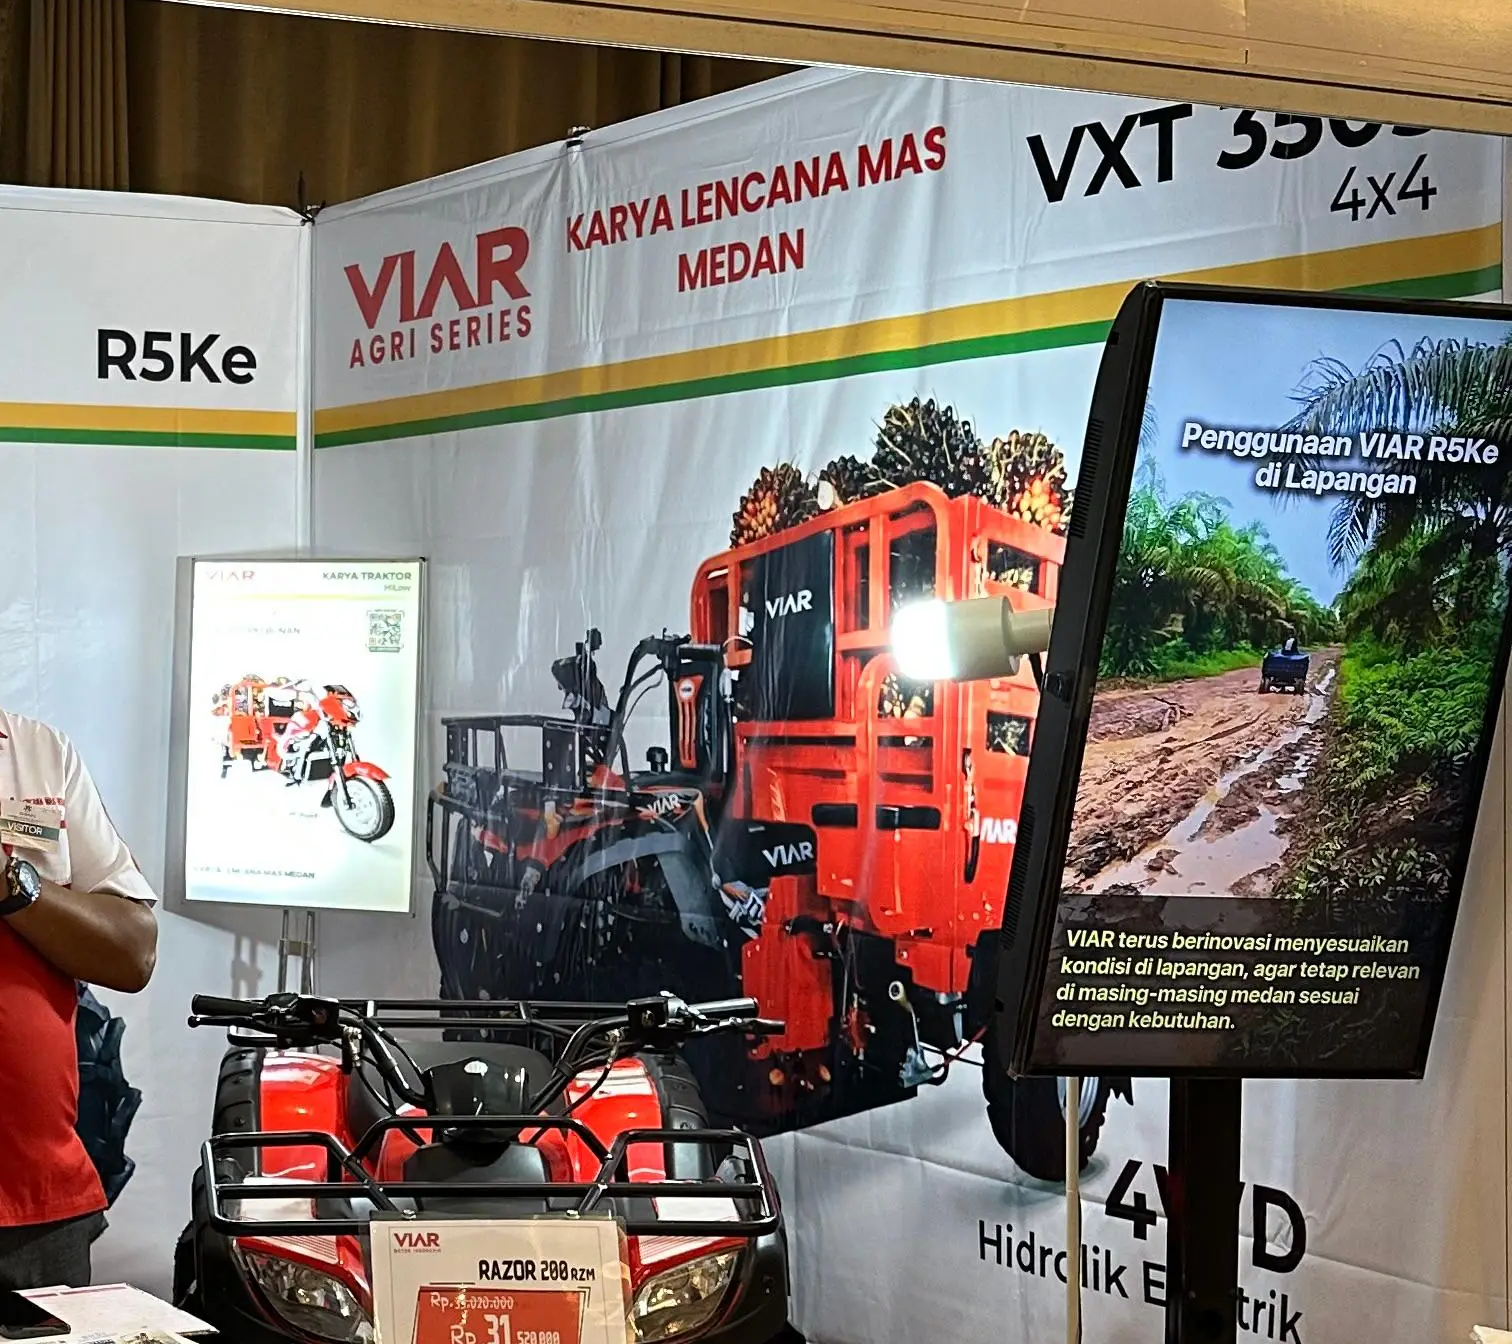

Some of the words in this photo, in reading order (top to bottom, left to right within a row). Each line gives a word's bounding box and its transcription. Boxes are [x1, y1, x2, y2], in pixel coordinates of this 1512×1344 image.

[1026, 103, 1192, 203] VXT
[567, 193, 674, 253] KARYA
[681, 152, 846, 228] LENCANA
[858, 125, 947, 188] MAS
[1330, 153, 1437, 221] 4x4
[678, 228, 805, 292] MEDAN
[344, 226, 531, 329] VIAR
[349, 331, 416, 369] AGRI
[431, 304, 532, 354] SERIES
[97, 329, 258, 385] R5Ke
[1182, 423, 1351, 458] Penggunaan
[1360, 432, 1422, 460] VIAR
[1428, 433, 1499, 464] R5Ke
[1255, 462, 1281, 488] di
[1285, 463, 1416, 499] Lapangan
[323, 572, 358, 580] KARYA
[362, 572, 412, 580] TRAKTOR
[765, 589, 813, 619] VIAR
[648, 794, 681, 815] VIAR
[7, 822, 43, 835] VISITOR
[762, 841, 814, 868] VIAR
[1066, 929, 1114, 949] VIAR
[1118, 933, 1168, 949] terus
[1171, 932, 1271, 951] berinovasi
[1275, 935, 1409, 956] menyesuaikan
[1060, 957, 1131, 976] kondisi
[1134, 959, 1152, 976] di
[1156, 960, 1248, 981] lapangan,
[1253, 965, 1297, 982] agar
[1300, 963, 1348, 982] tetap
[1352, 963, 1420, 980] relevan
[1056, 984, 1074, 1001] di
[1079, 984, 1227, 1009] masing-masing
[1231, 988, 1295, 1004] medan
[1299, 987, 1359, 1005] sesuai
[1052, 1010, 1124, 1031] dengan
[1128, 1011, 1235, 1029] kebutuhan.
[1105, 1159, 1307, 1274] 4D
[393, 1232, 440, 1247] VIAR
[479, 1260, 537, 1280] RAZOR
[541, 1260, 568, 1281] 200
[571, 1268, 596, 1281] RZM
